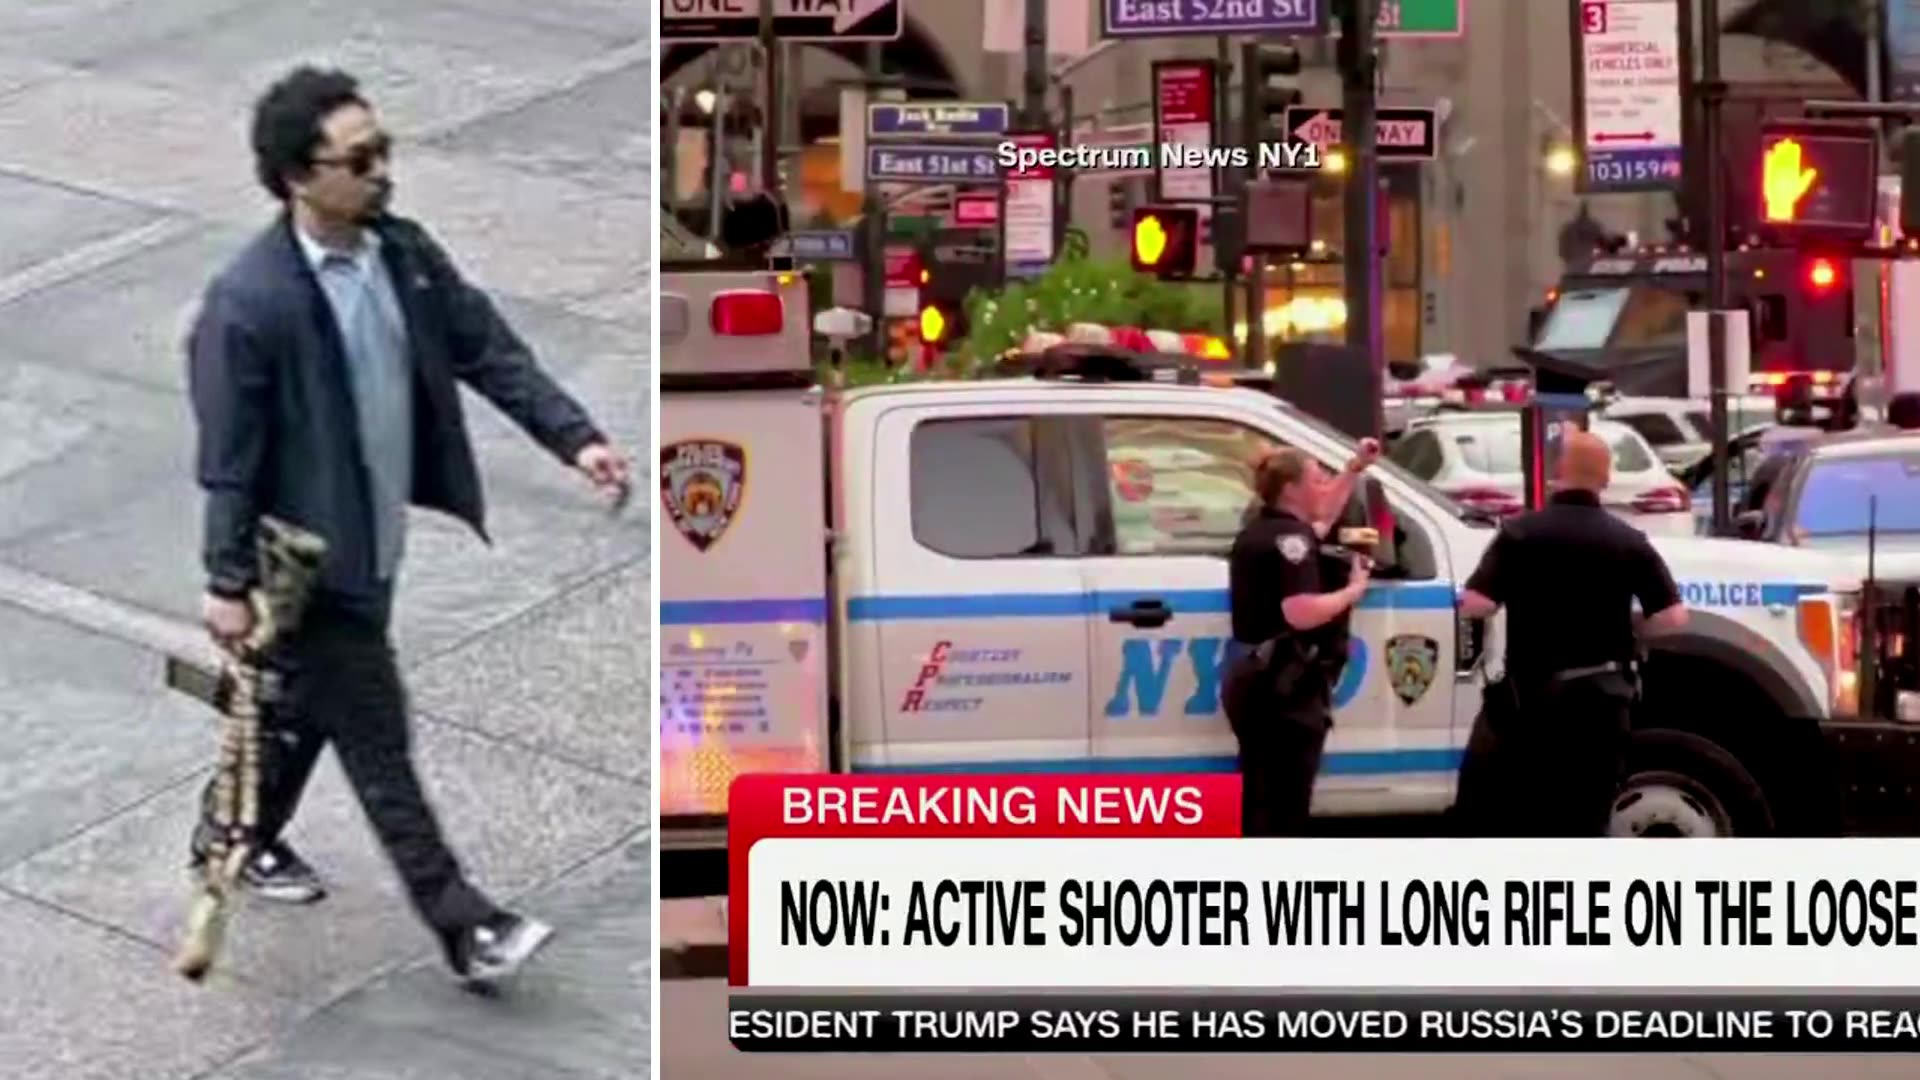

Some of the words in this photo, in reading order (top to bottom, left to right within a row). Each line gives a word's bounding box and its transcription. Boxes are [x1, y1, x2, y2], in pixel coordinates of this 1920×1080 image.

[1118, 0, 1182, 21] East
[1192, 0, 1256, 19] 52nd
[1271, 0, 1305, 17] St
[1586, 5, 1603, 33] 3
[879, 154, 924, 173] East
[928, 155, 968, 174] 51st
[973, 155, 995, 174] St
[1589, 160, 1661, 180] 103159
